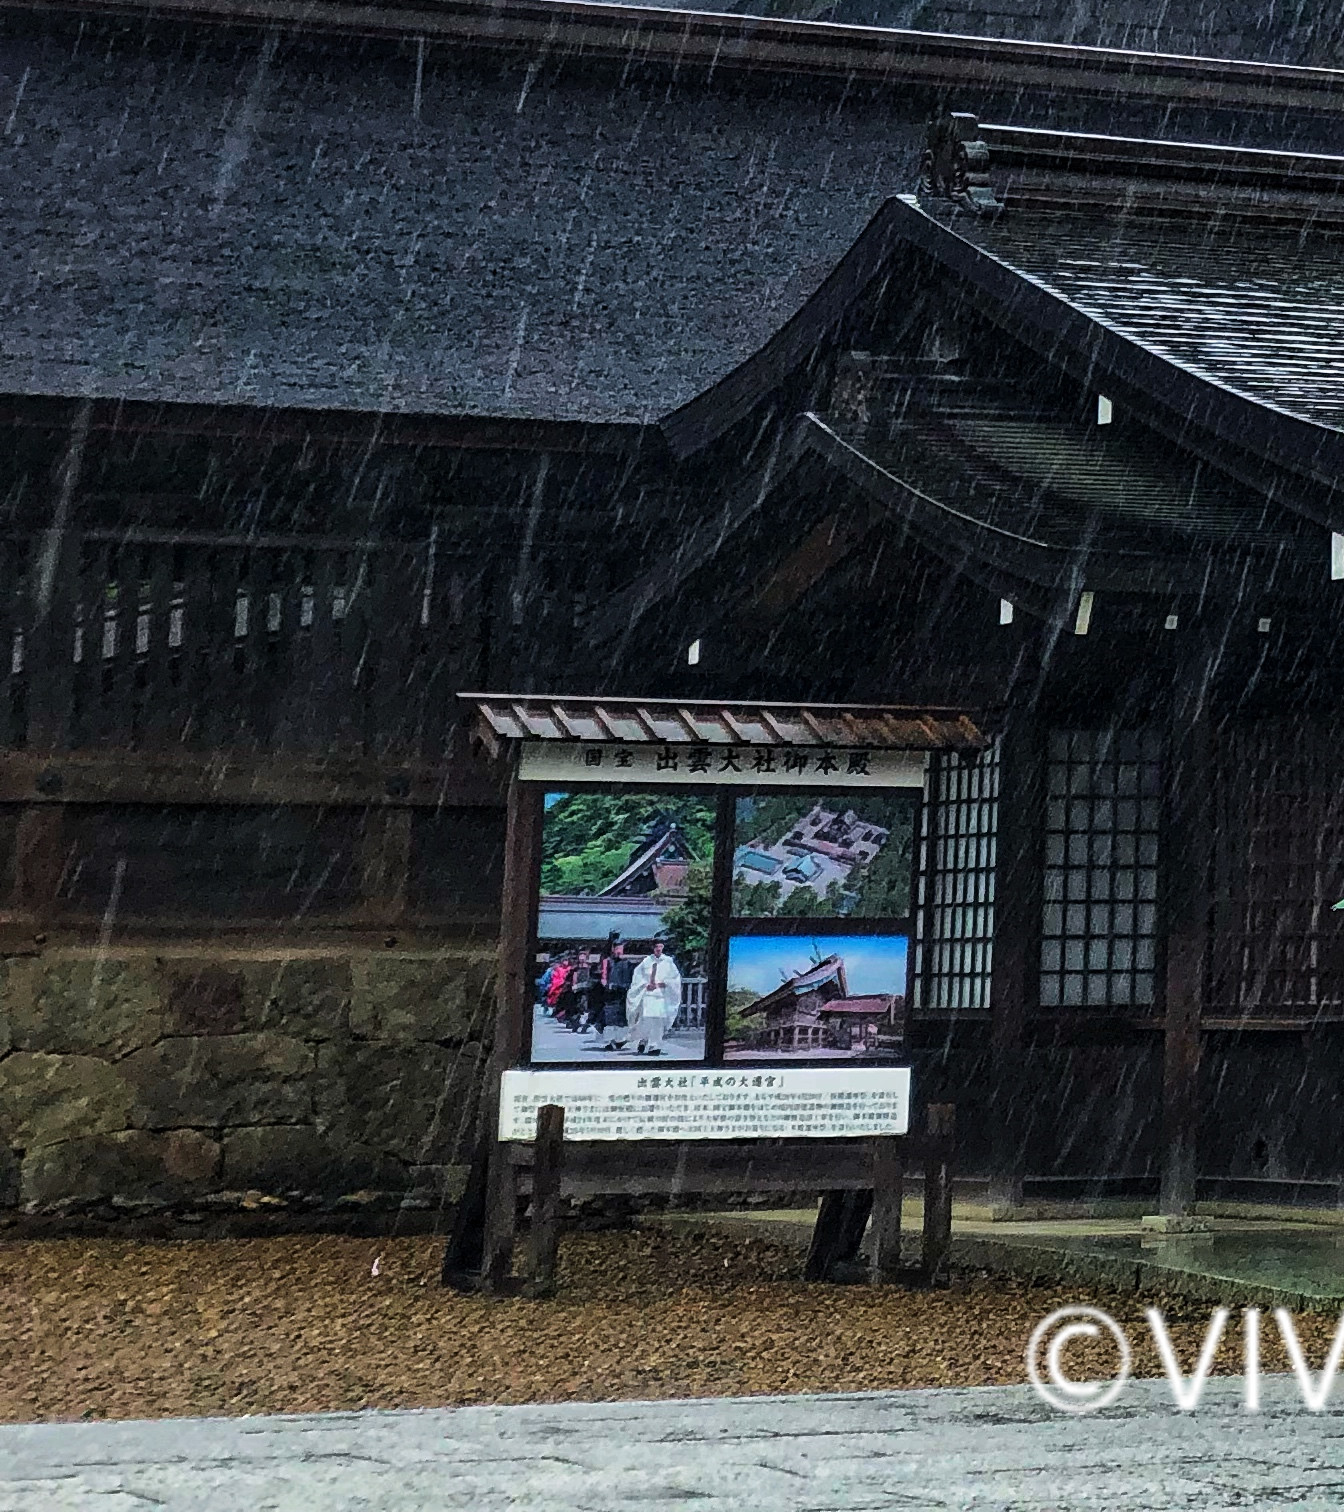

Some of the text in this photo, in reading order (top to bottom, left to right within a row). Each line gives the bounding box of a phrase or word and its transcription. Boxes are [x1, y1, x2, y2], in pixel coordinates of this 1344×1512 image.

[584, 746, 872, 776] 国宝 出雲大社御本殿
